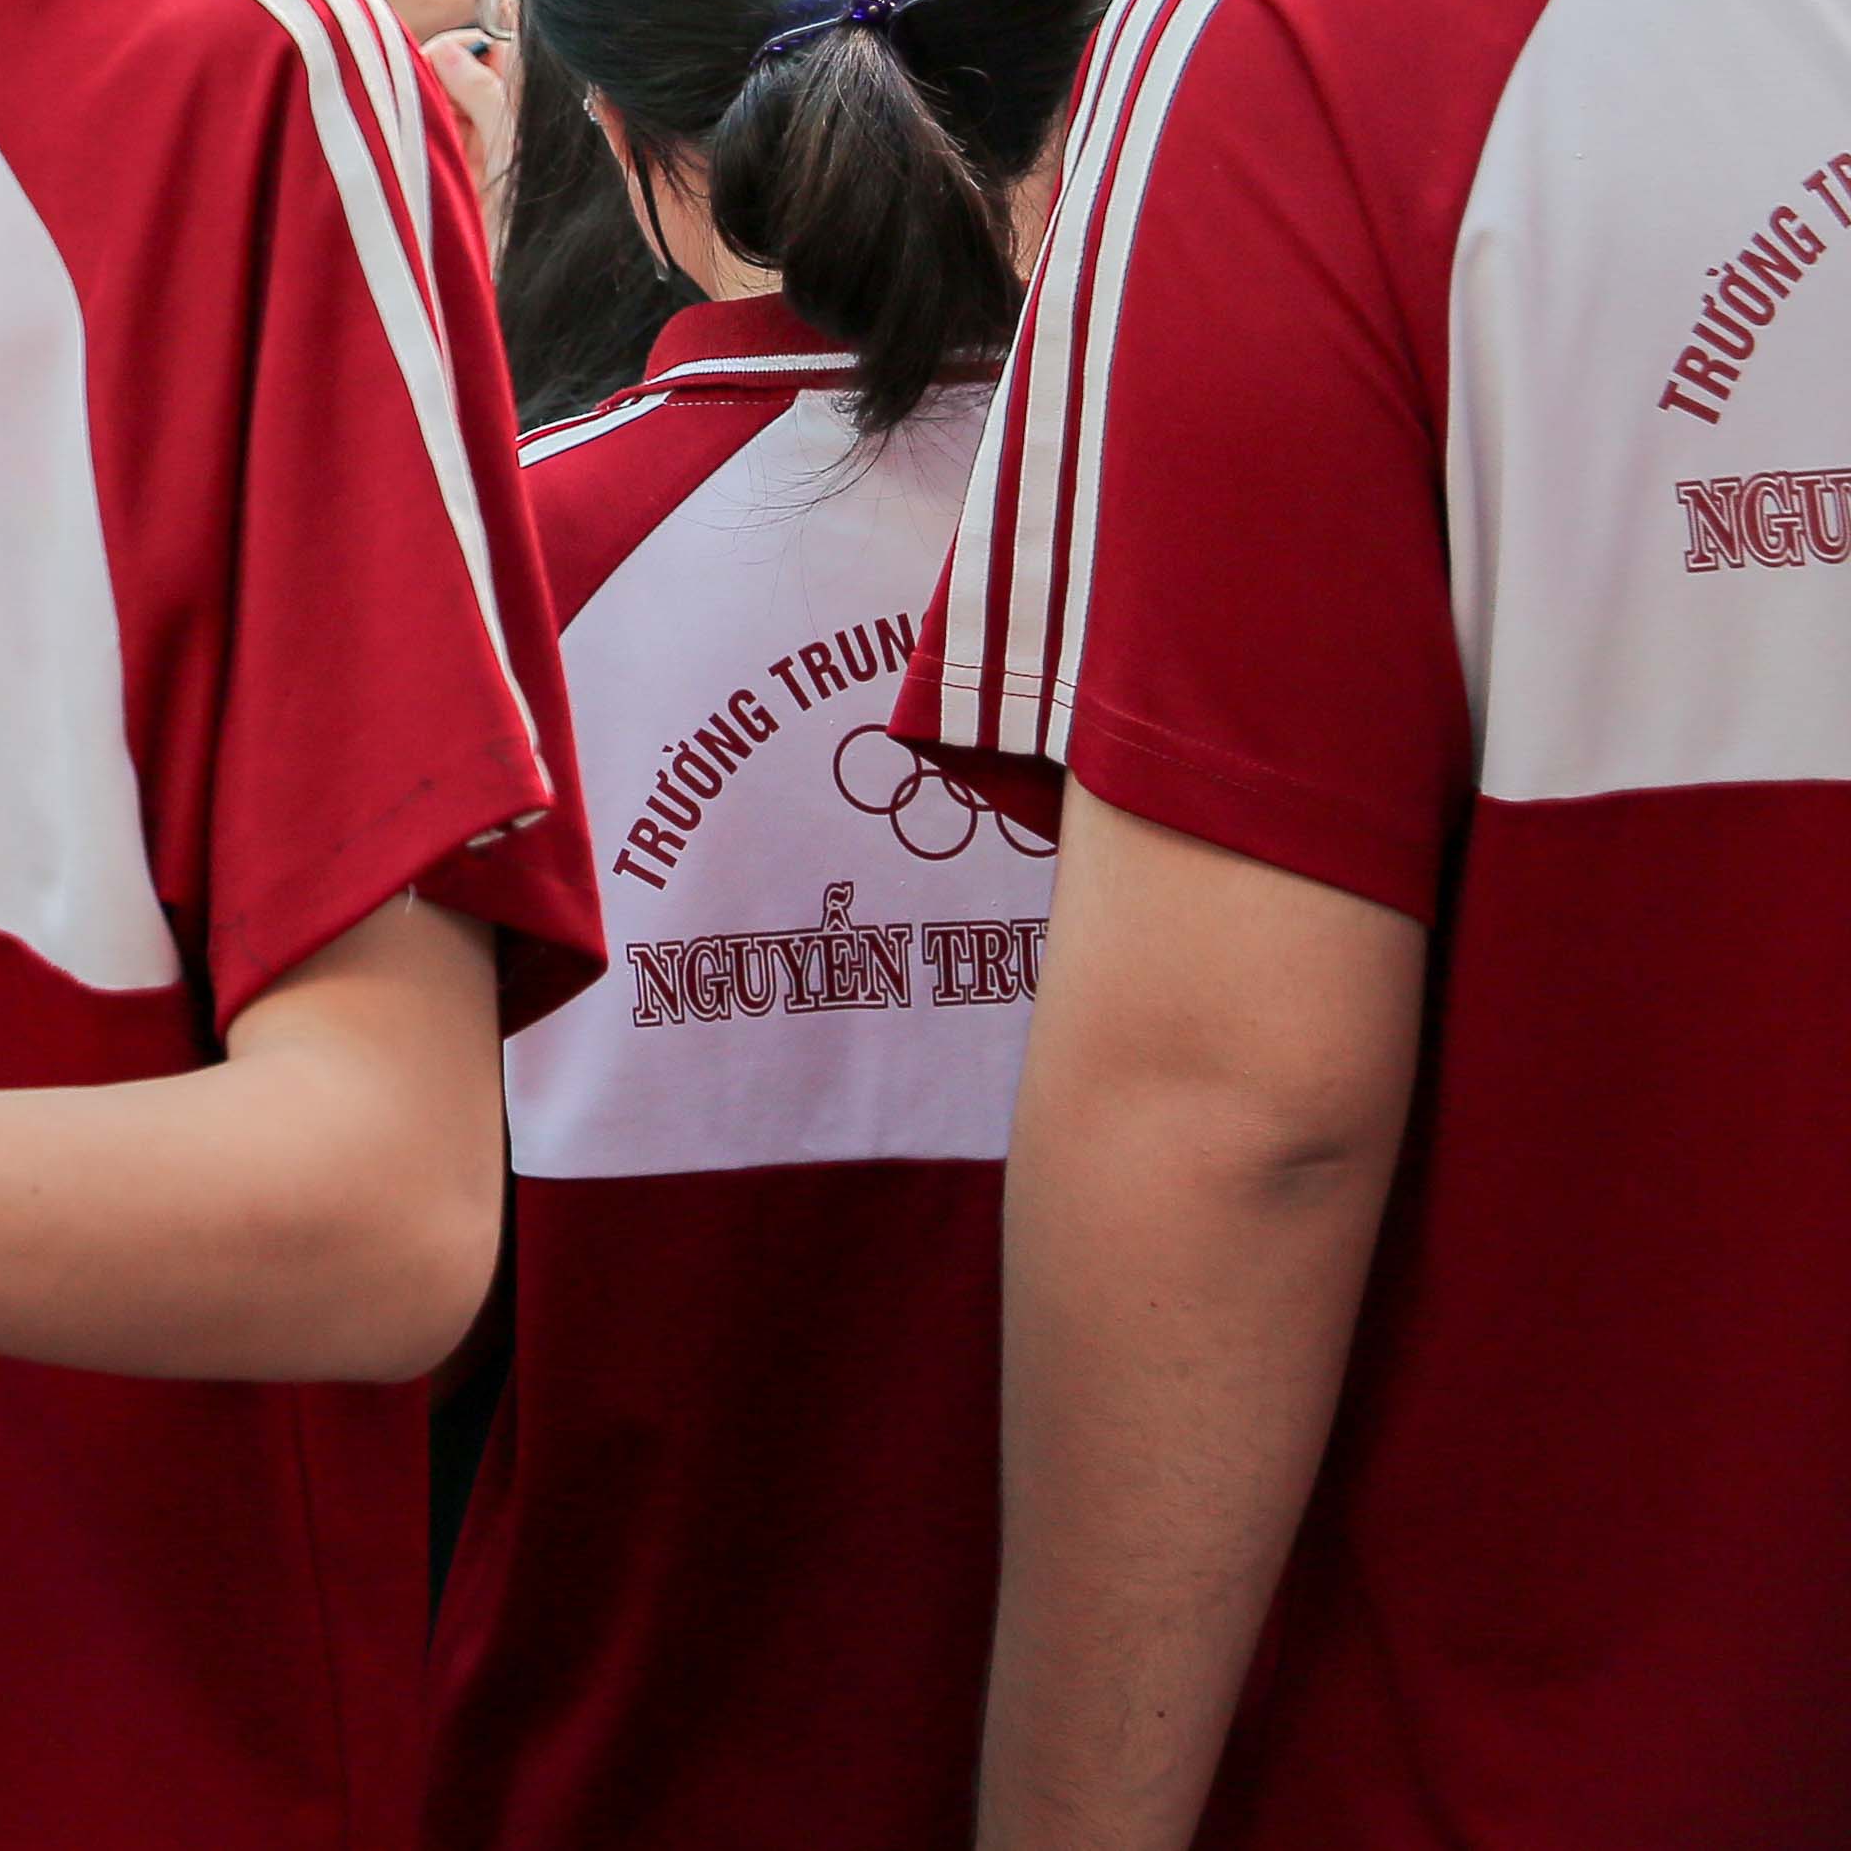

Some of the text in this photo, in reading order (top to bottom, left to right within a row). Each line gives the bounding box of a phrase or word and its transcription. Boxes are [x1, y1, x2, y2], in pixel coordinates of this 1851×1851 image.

[1658, 204, 1827, 425] TRƯỜNG
[1675, 467, 1851, 573] NGU
[612, 612, 928, 891] TRƯỜNG TRUN
[627, 881, 1050, 1028] NGUYỄN TRU
